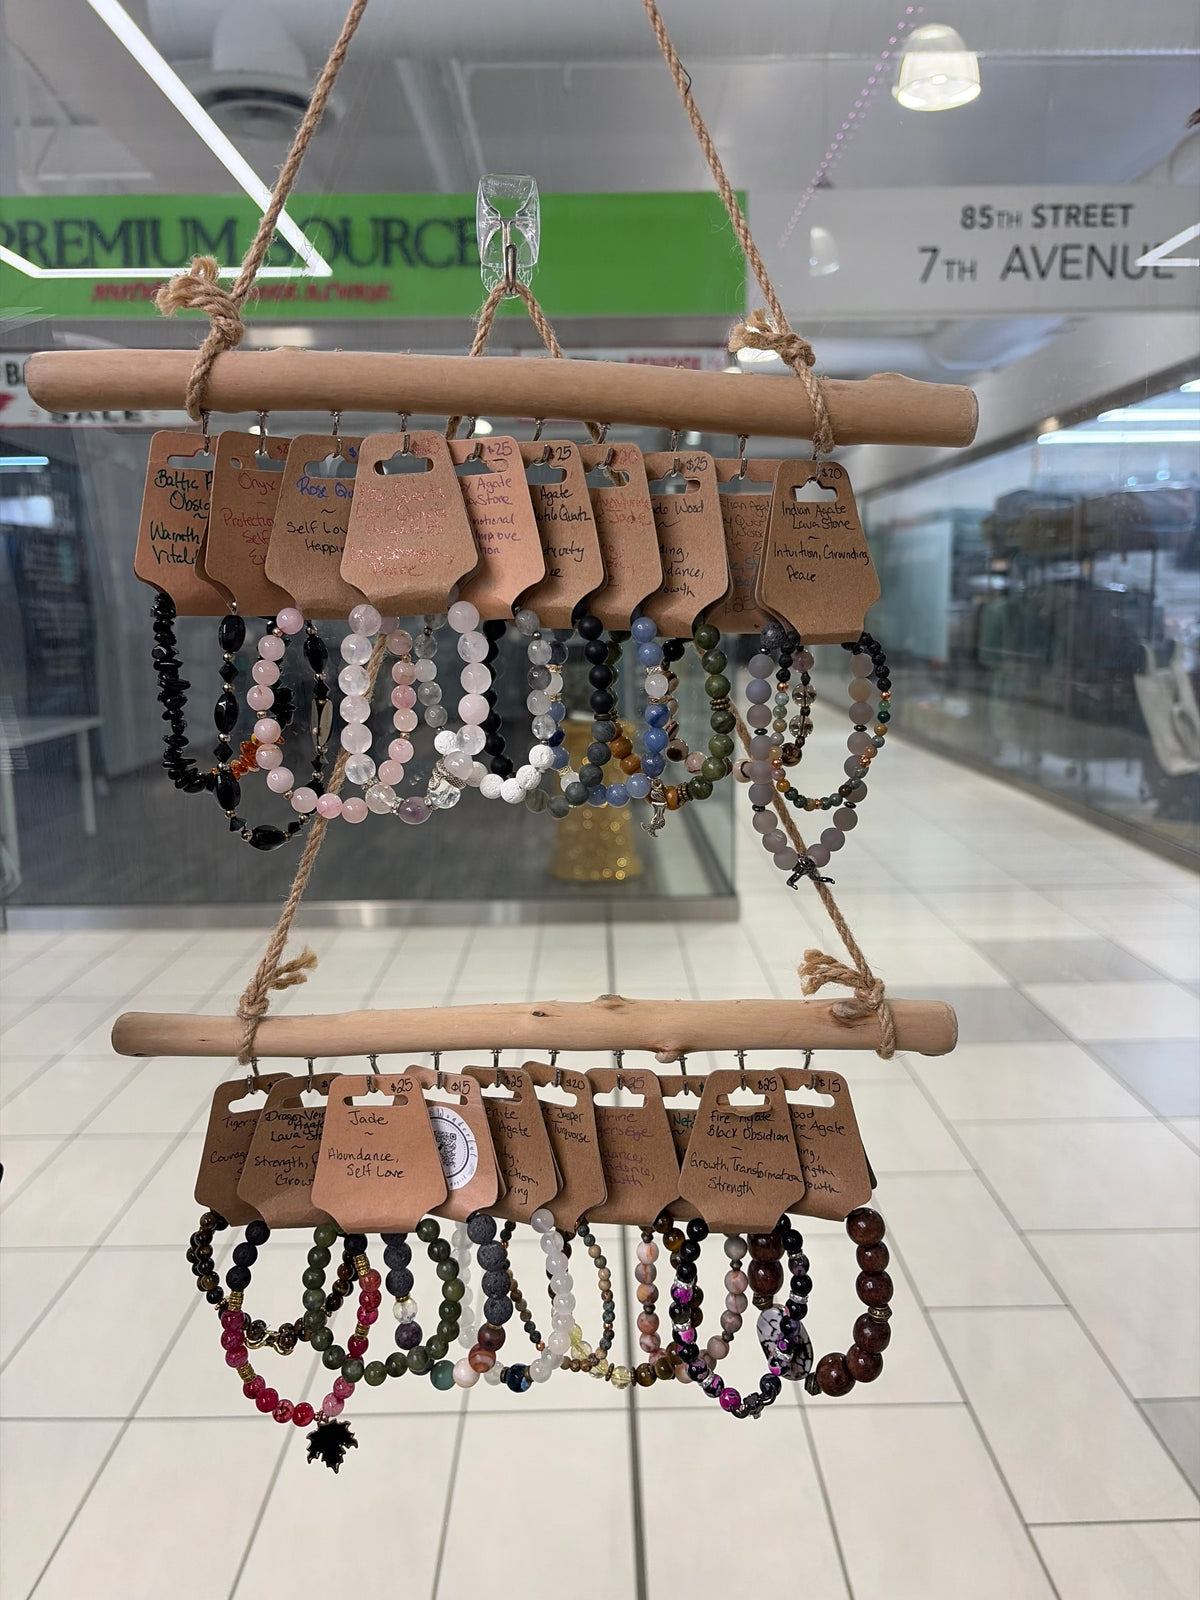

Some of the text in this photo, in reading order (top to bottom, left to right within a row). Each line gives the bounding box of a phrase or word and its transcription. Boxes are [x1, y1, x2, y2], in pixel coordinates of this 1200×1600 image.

[961, 203, 1134, 230] 85TH STREET
[918, 243, 1177, 284] 7TH AVENUE
[487, 441, 513, 457] $25
[686, 456, 708, 472] $25
[154, 469, 199, 490] Baltic
[821, 467, 842, 480] $20
[238, 472, 276, 495] Onyx
[297, 476, 329, 498] Rose
[477, 475, 512, 494] Agate
[540, 484, 574, 506] Agate
[675, 498, 705, 515] Wood
[782, 501, 847, 519] Indian Agate
[220, 507, 275, 528] Protectio
[792, 517, 818, 531] Lava
[150, 519, 201, 545] Warmth
[286, 521, 348, 535] Self Lov
[823, 544, 870, 566] Grounding
[786, 565, 817, 582] Peace
[390, 1078, 414, 1094] $25
[451, 1080, 471, 1095] $15
[504, 1075, 523, 1088] $25
[565, 1079, 585, 1090] $20
[758, 1077, 778, 1092] $25
[818, 1078, 841, 1093] $15
[348, 1110, 389, 1125] Jade
[554, 1107, 584, 1126] Jasper
[270, 1130, 301, 1143] Lava
[499, 1120, 532, 1138] Agate
[552, 1120, 590, 1143] Turquoise
[706, 1124, 790, 1143] Black Obsidian
[810, 1120, 847, 1137] Agate
[210, 1150, 248, 1165] Courag
[328, 1147, 400, 1163] Abundance,
[254, 1155, 309, 1173] Strength,
[347, 1163, 405, 1178] Self Love
[275, 1173, 315, 1187] Grow
[708, 1177, 756, 1198] Strength
